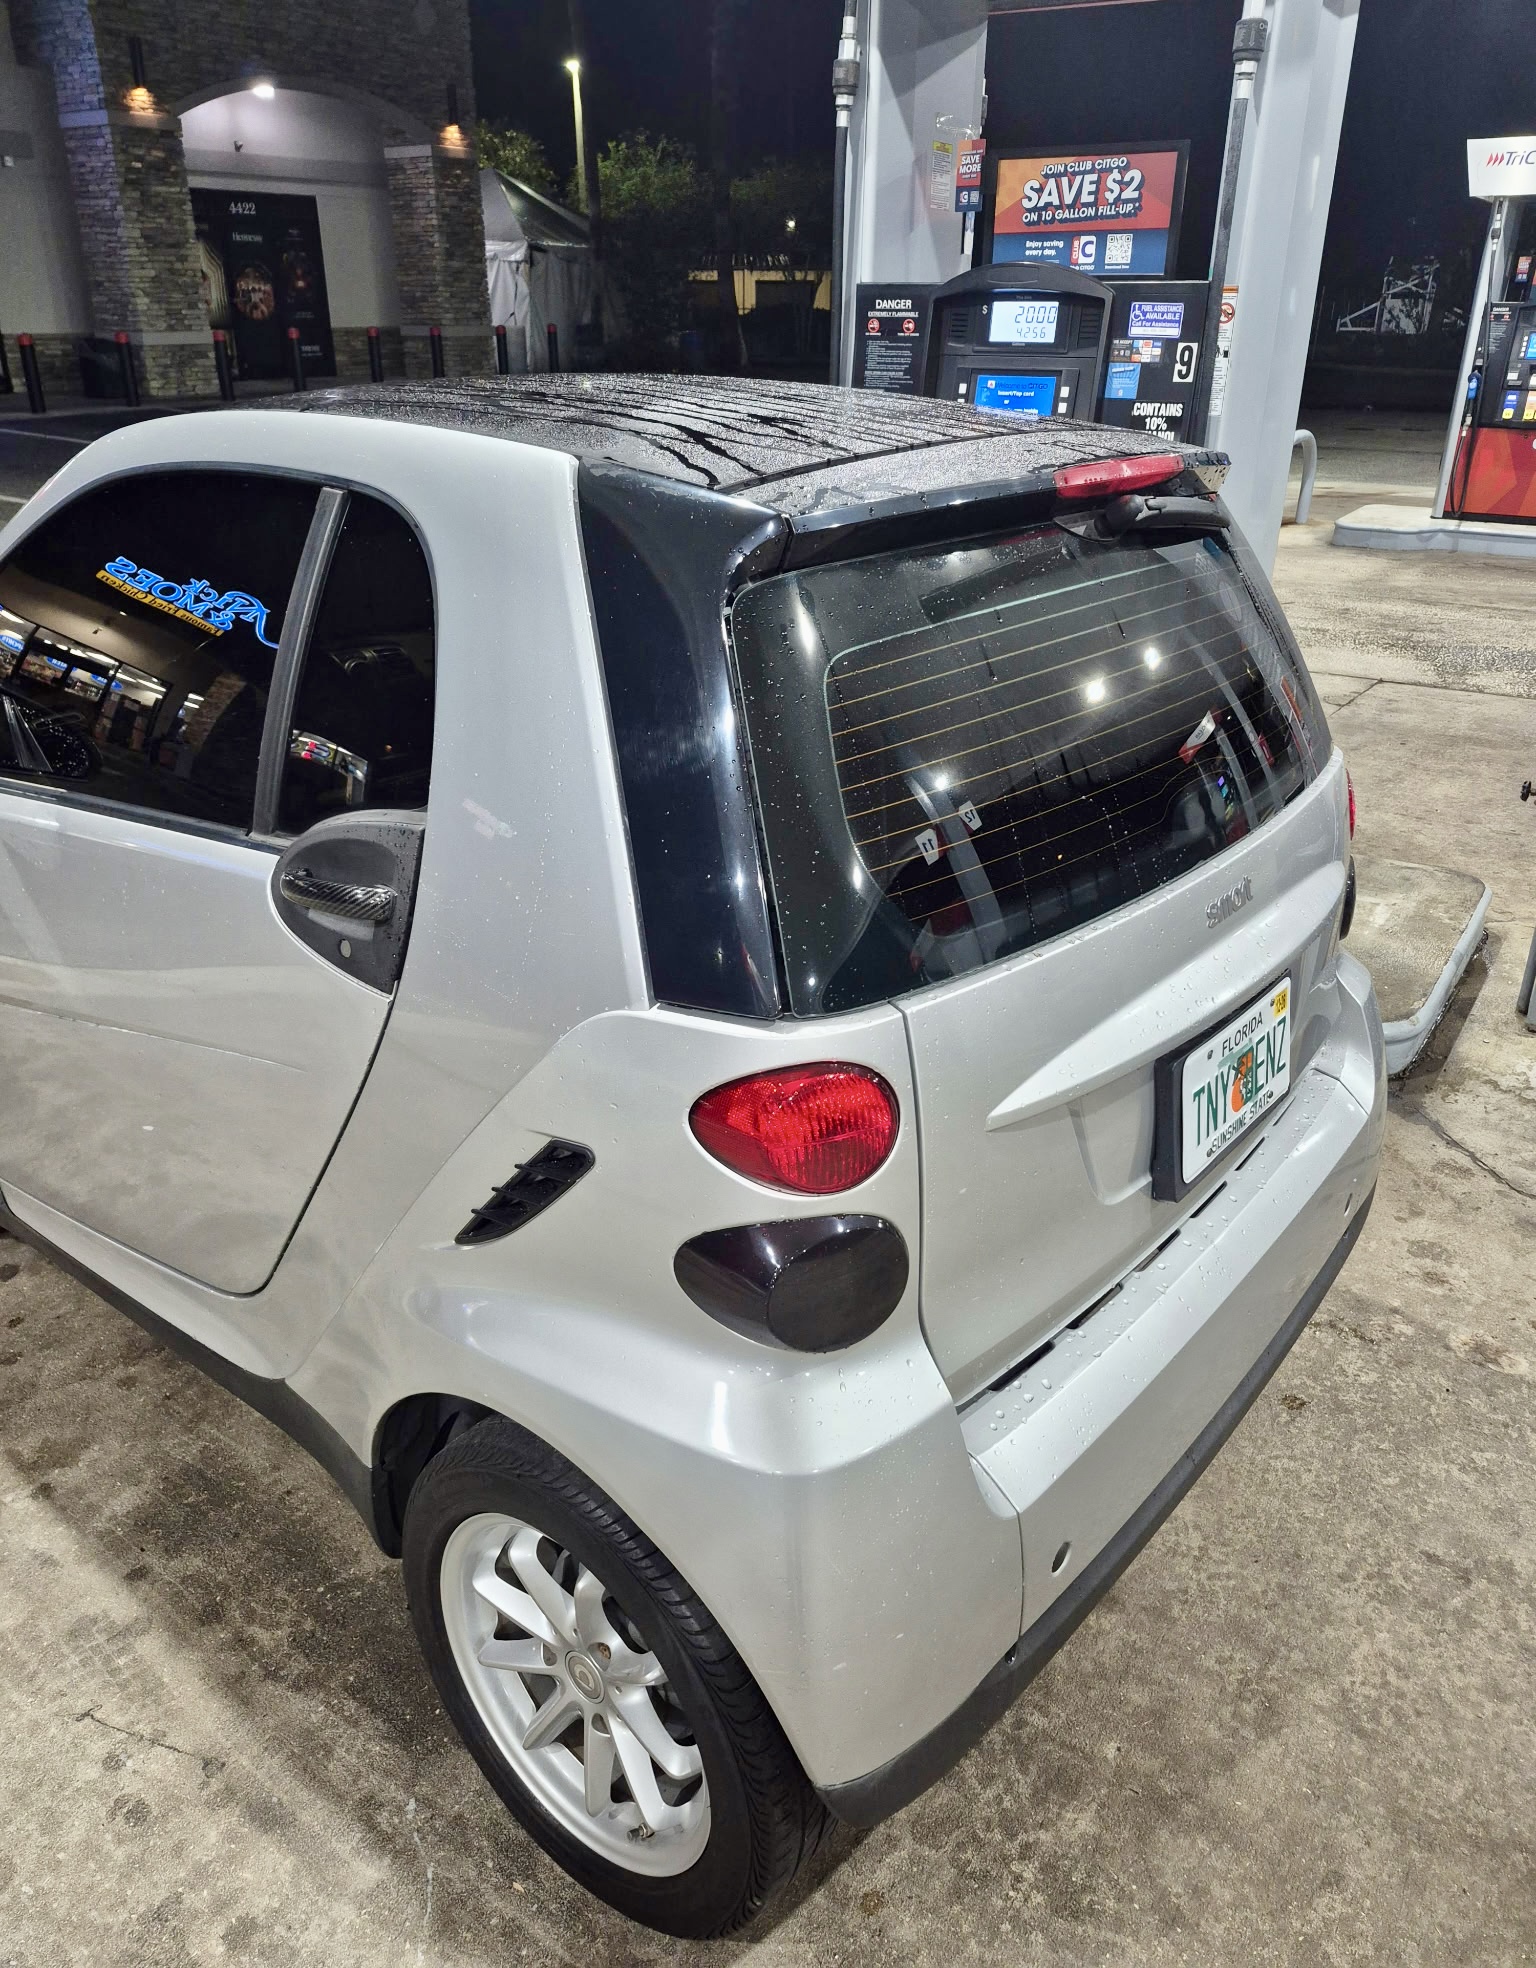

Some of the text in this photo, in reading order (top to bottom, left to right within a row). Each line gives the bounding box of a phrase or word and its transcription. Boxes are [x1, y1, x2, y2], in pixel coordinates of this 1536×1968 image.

[961, 155, 981, 165] SAVE
[1041, 157, 1127, 175] JOIN CLUB CITGO
[959, 164, 982, 174] MORE
[1021, 169, 1142, 209] SAVE $2
[229, 201, 256, 214] 4422
[1022, 212, 1039, 223] ON
[1041, 211, 1052, 221] 10
[1055, 207, 1095, 220] GALLON
[1025, 240, 1064, 248] Enjoy saving
[1072, 240, 1080, 259] CLUB
[1081, 240, 1095, 258] C
[875, 299, 912, 309] DANGER
[982, 305, 988, 315] $
[1177, 345, 1194, 380] 9
[1133, 402, 1184, 417] CONTAINS
[1145, 417, 1168, 430] 10%
[1205, 875, 1253, 929] smart
[1221, 1011, 1263, 1058] FLORIDA
[1211, 1089, 1271, 1154] SUNSHINE STATE
